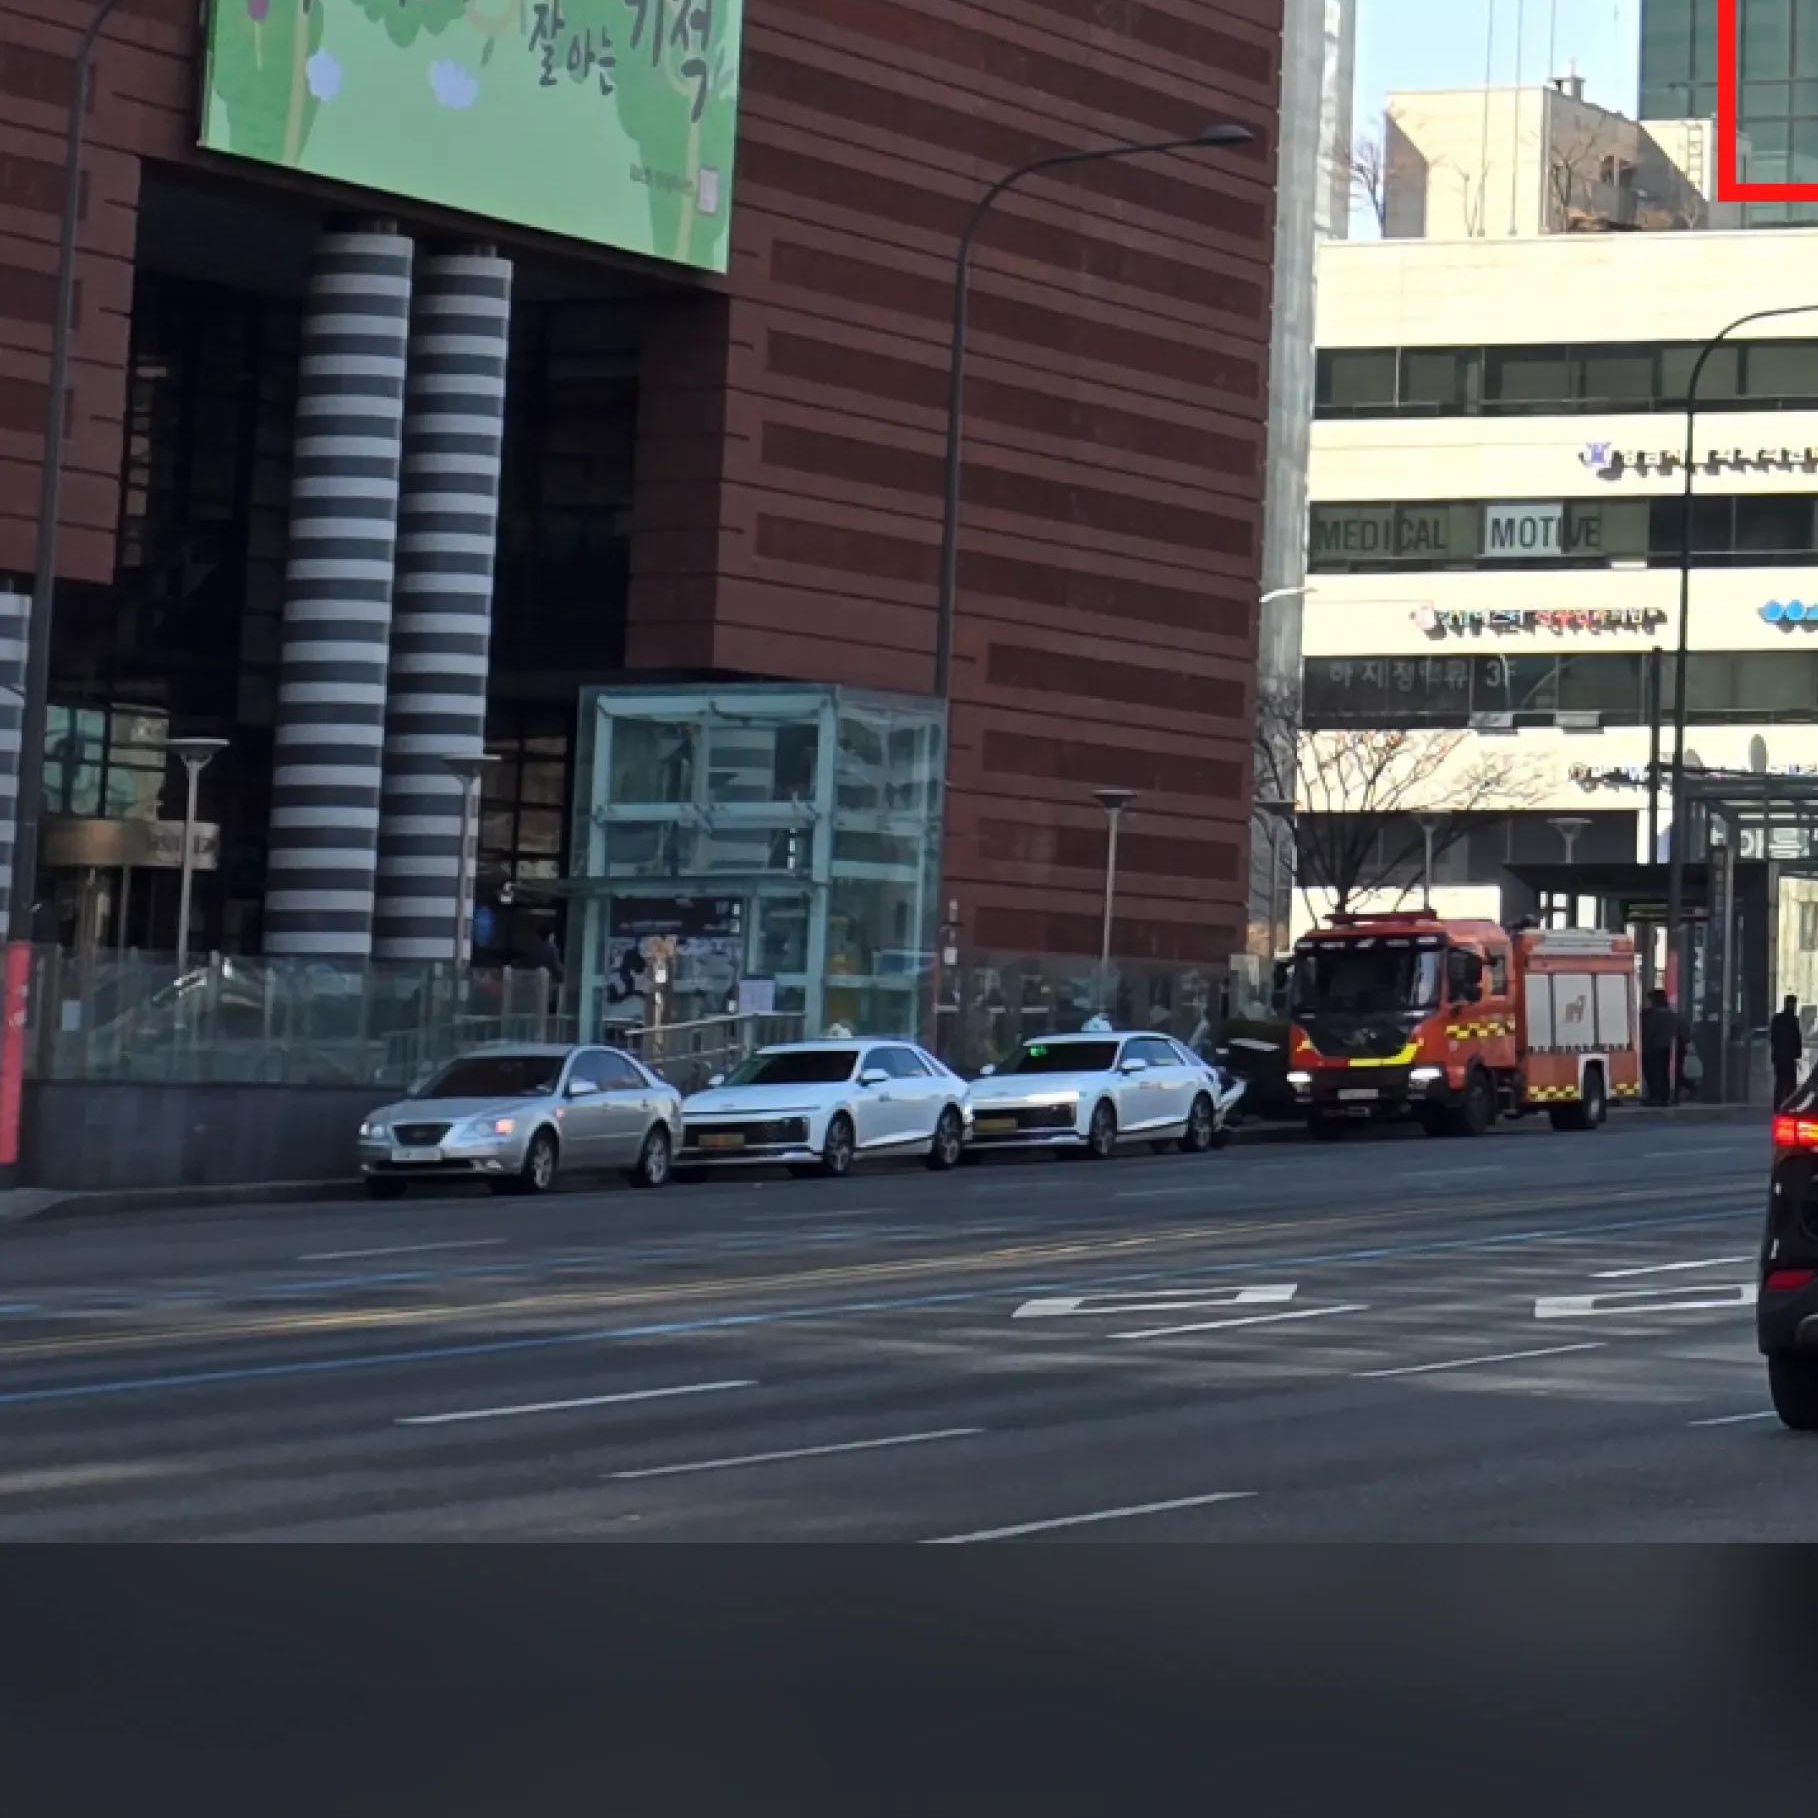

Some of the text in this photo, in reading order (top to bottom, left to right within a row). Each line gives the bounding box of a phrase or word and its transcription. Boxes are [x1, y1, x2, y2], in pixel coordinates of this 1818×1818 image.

[529, 0, 565, 88] 잘
[566, 24, 618, 97] 아는
[1316, 515, 1603, 552] MEDICAL MOTIVE
